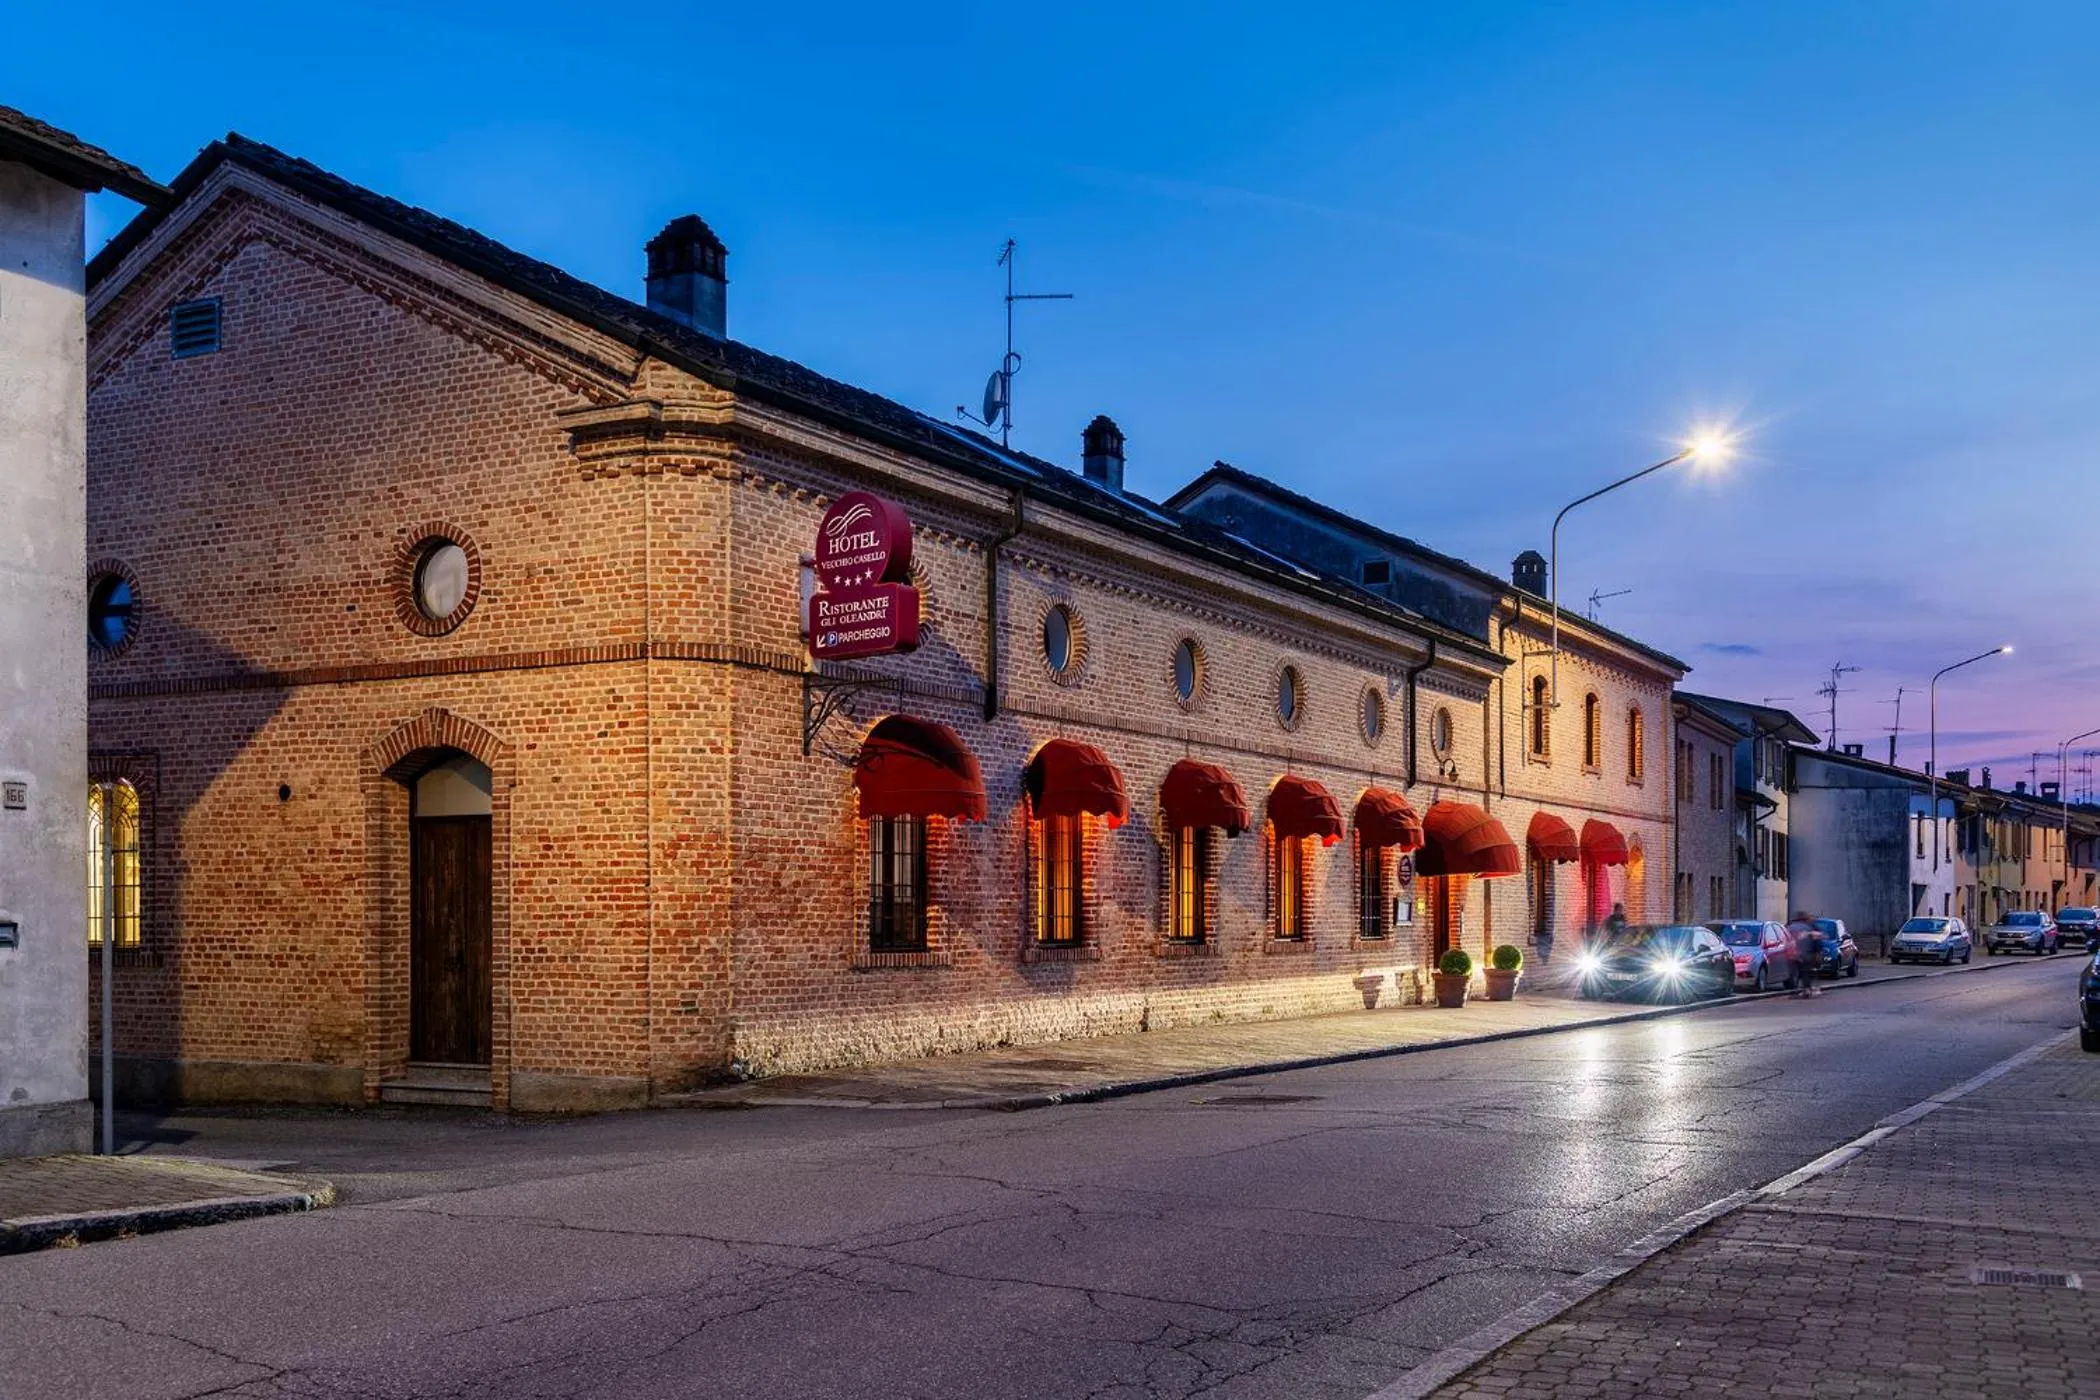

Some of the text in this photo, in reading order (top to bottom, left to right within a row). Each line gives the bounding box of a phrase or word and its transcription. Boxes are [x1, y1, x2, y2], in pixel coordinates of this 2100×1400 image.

[828, 531, 880, 554] HOTEL
[821, 551, 886, 569] VECCHIO CASELLO
[819, 596, 889, 617] RISTORANTE
[821, 609, 886, 627] GLI OLEANDRI
[838, 626, 890, 643] PARCHEGGIO
[6, 789, 24, 802] 166
